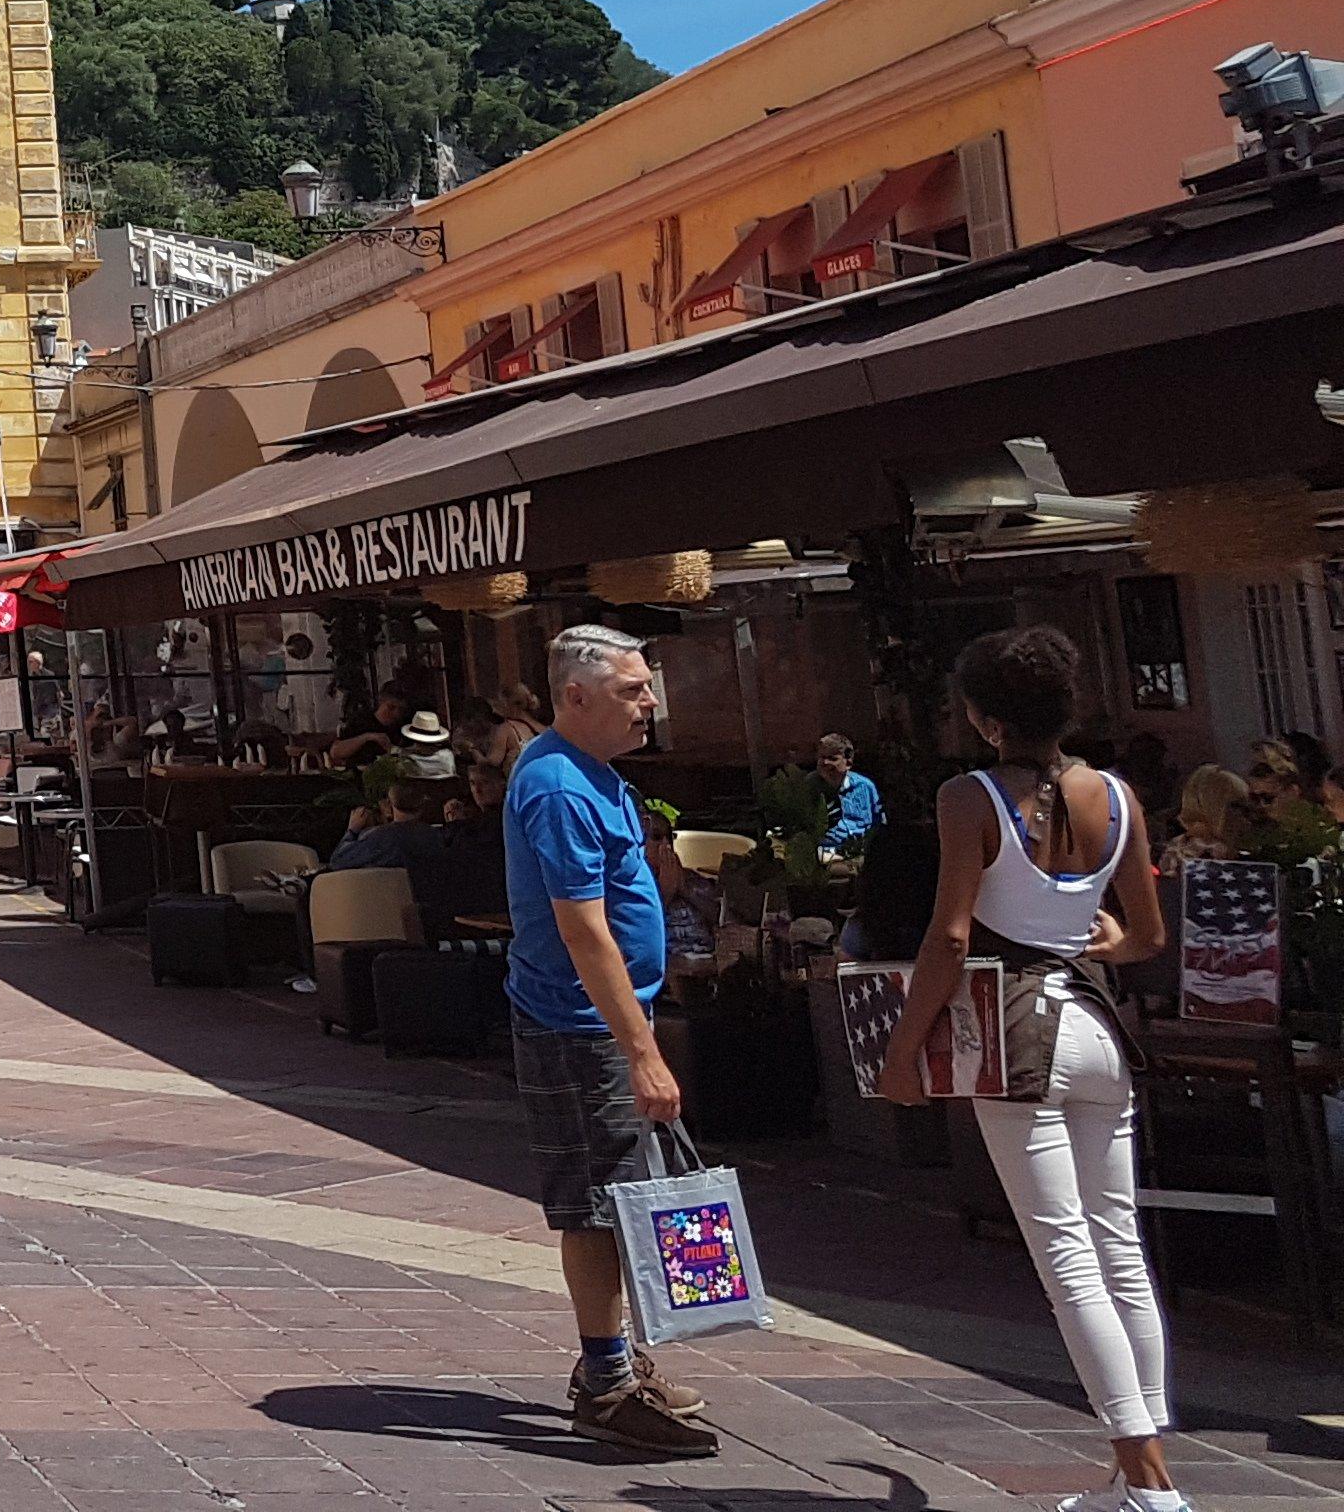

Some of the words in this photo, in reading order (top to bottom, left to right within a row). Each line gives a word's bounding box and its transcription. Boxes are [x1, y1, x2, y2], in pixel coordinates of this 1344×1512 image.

[826, 254, 862, 277] GLACES
[179, 543, 279, 611] AMERICAN
[350, 490, 532, 586] RESTAURANT
